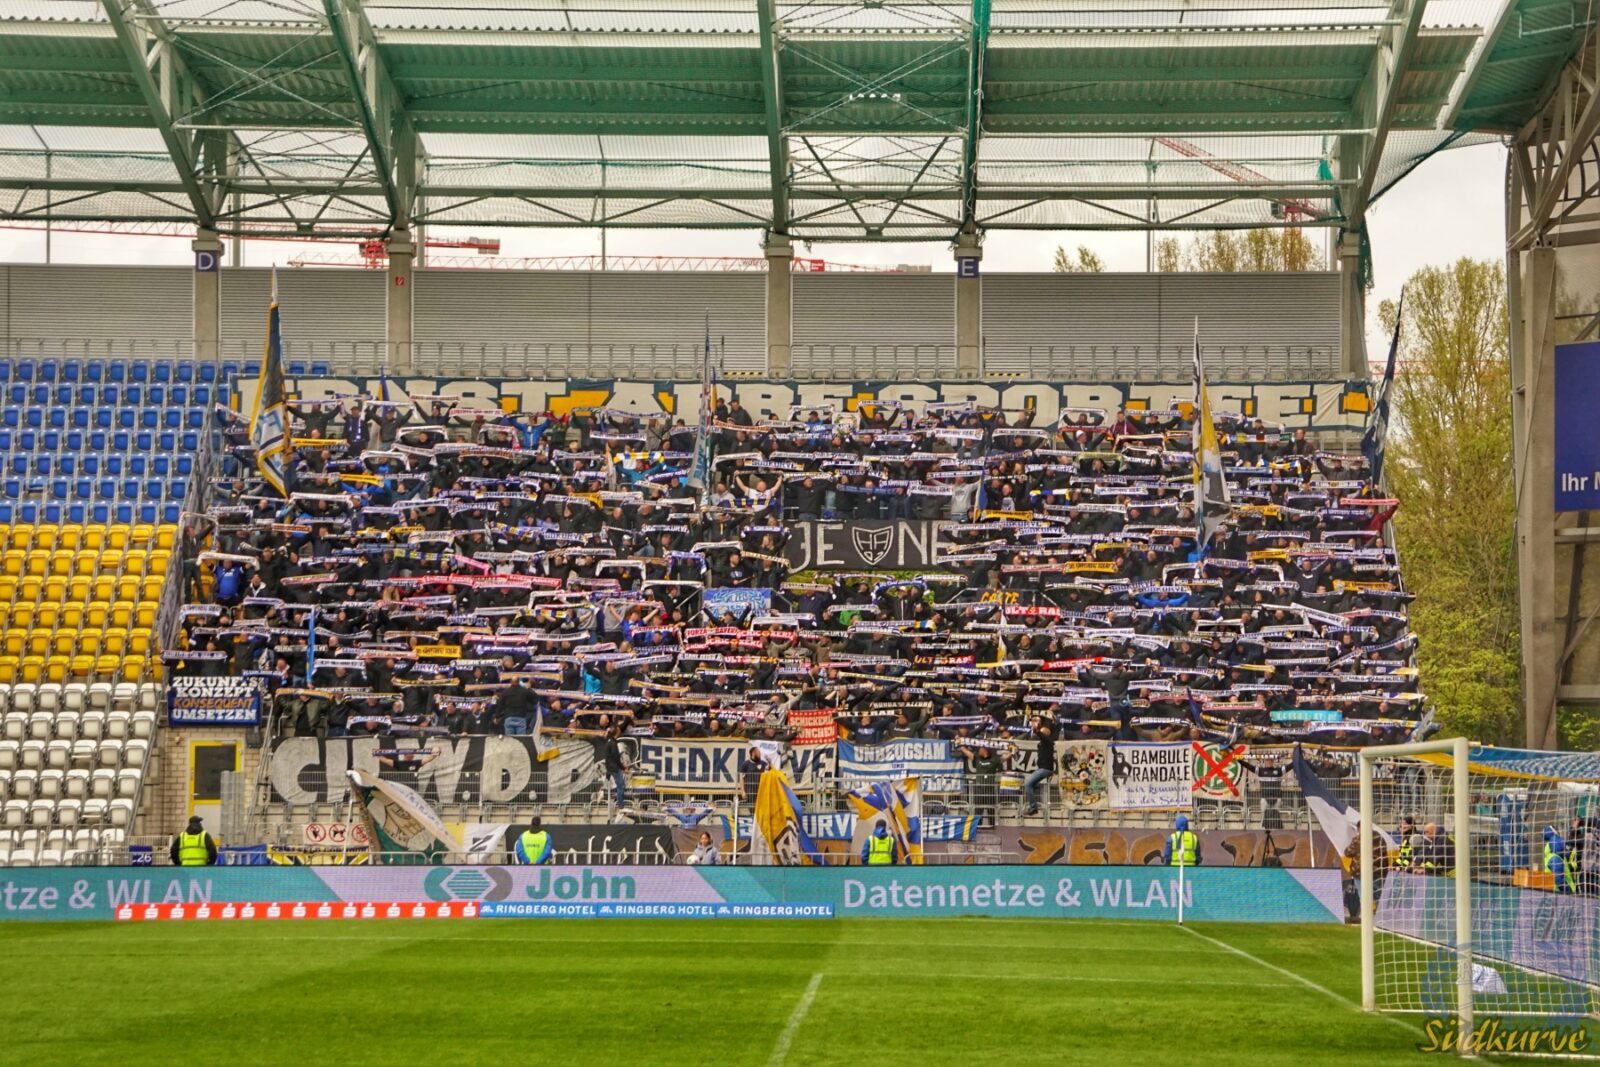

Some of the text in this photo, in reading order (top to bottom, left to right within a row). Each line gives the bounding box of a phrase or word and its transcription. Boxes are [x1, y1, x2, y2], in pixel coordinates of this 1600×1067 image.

[197, 252, 214, 270] D
[961, 258, 975, 276] E
[1561, 473, 1588, 492] Ihr
[176, 687, 254, 697] KONZEPT
[174, 697, 254, 708] KONSEQUENT
[172, 709, 257, 720] UMSETZEN
[795, 727, 835, 738] ÜNCHEN
[854, 742, 946, 762] UNBEUGSAM
[1132, 748, 1189, 764] BAMBULE
[641, 744, 834, 786] SÜDKVE
[1132, 766, 1190, 782] RANDALE
[526, 868, 636, 900] John
[0, 879, 213, 910] tze & WLAN
[843, 878, 1193, 908] Datennetze & WLAN
[496, 904, 596, 914] RINGBERG HOTEL
[615, 904, 715, 915] RINGBERG HOTEL
[733, 905, 832, 915] RINGBERG HOTEL
